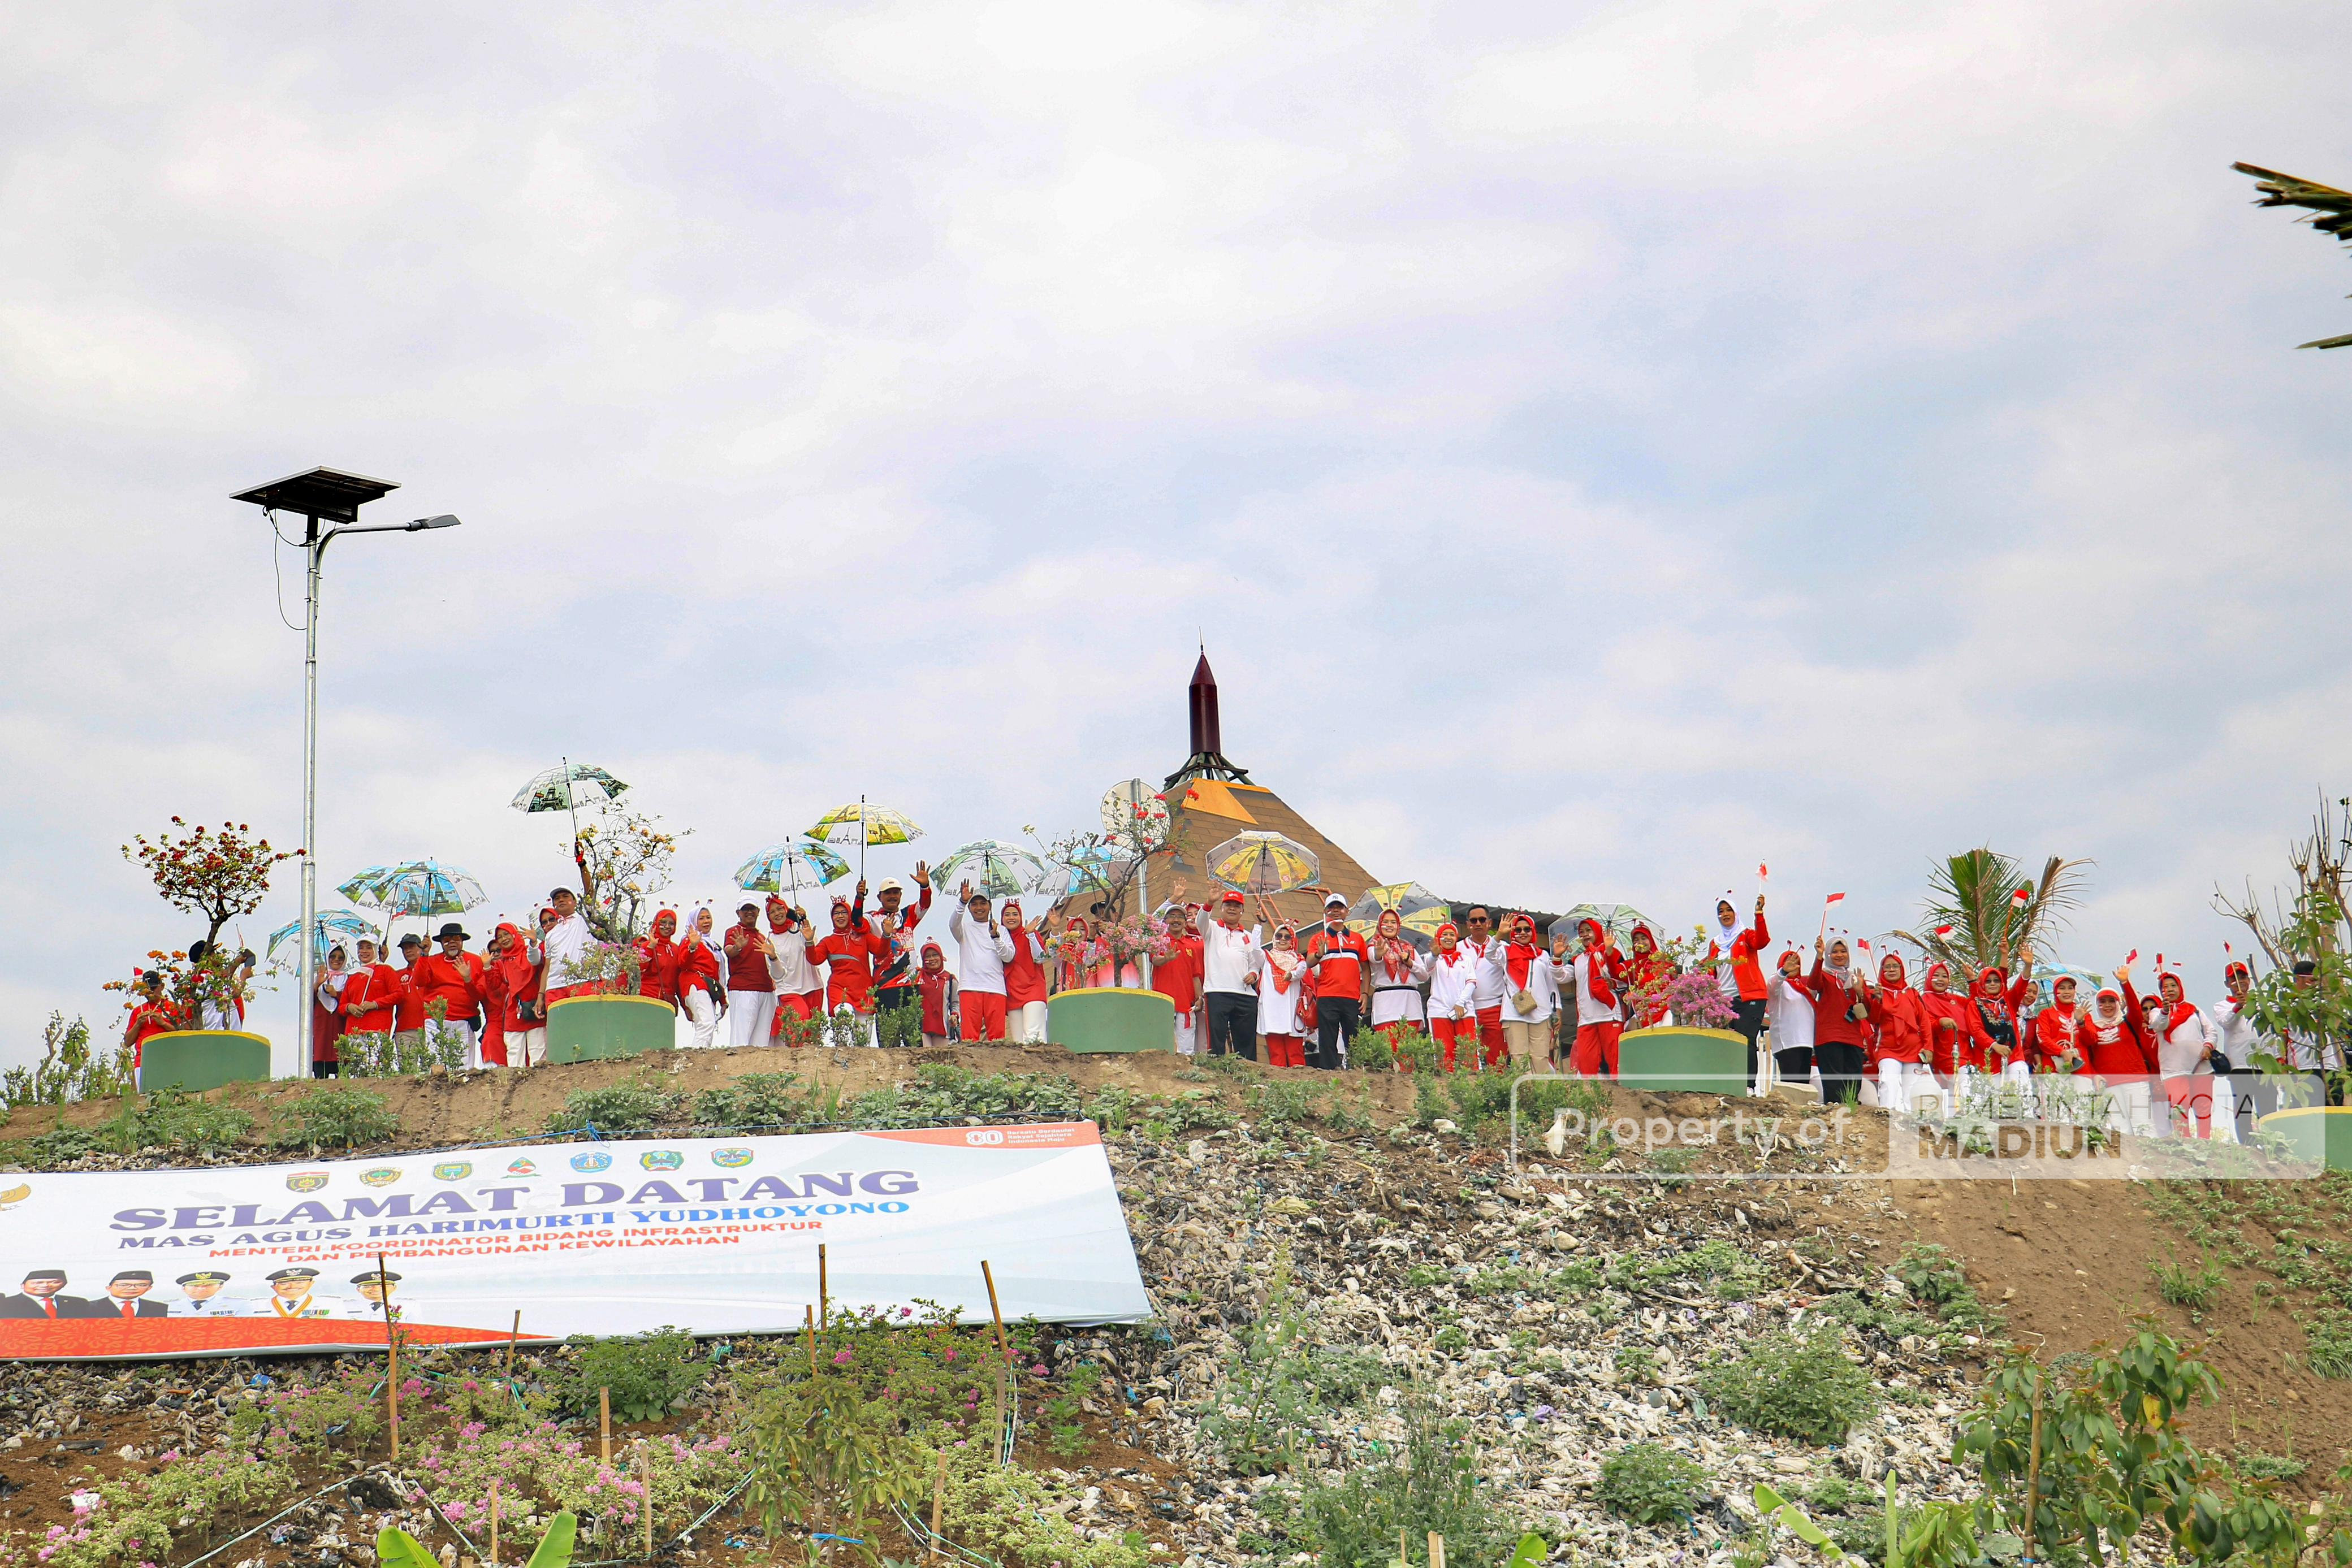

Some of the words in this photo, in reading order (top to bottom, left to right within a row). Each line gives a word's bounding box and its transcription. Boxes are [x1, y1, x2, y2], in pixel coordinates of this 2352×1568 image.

[966, 1130, 1004, 1145] 80
[110, 1186, 530, 1231] SELAMAT
[560, 1171, 920, 1207] DATANG
[118, 1235, 215, 1249] MAS
[229, 1228, 352, 1245] AGUS
[367, 1211, 615, 1237] HARIMURTI
[630, 1201, 909, 1222] YUDHOYONO
[209, 1245, 320, 1258] MENTERI
[331, 1236, 509, 1251] KOORDINATOR
[520, 1229, 613, 1242] BIDANG
[624, 1221, 823, 1236] INFRASTRUKTUR
[287, 1253, 338, 1262] DAN
[350, 1243, 549, 1259] PEMBANGUNAN
[560, 1236, 738, 1250] KEWILAYAHAN
